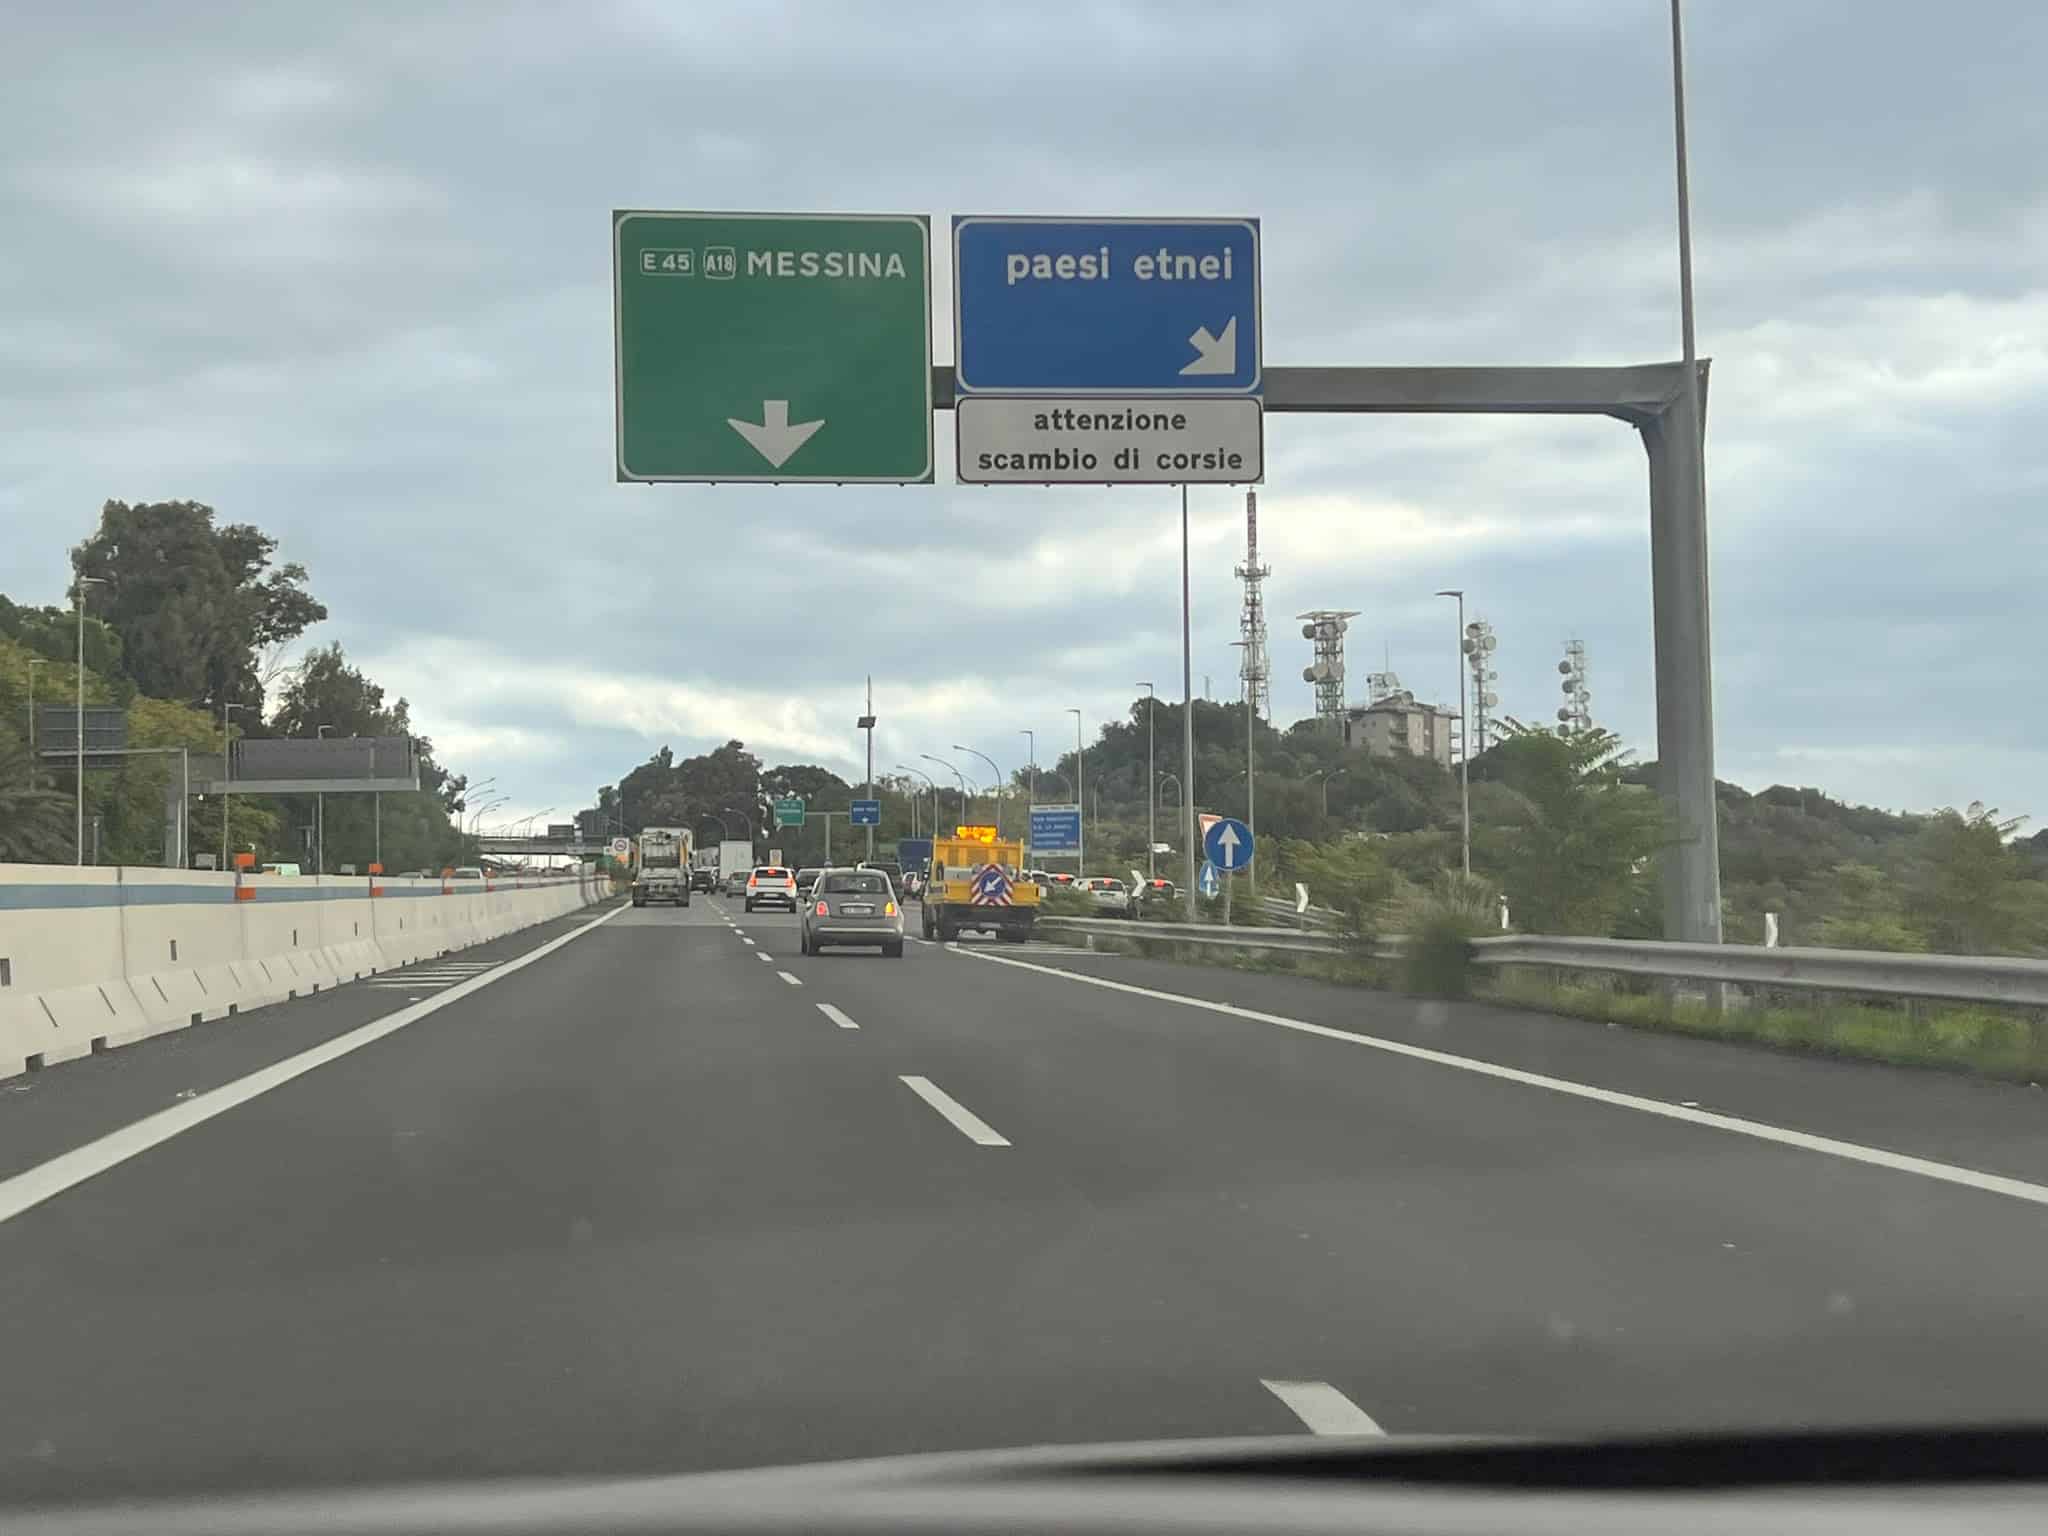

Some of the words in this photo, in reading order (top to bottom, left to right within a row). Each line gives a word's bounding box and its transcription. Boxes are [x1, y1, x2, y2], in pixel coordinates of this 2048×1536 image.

[643, 252, 656, 271] E
[660, 252, 690, 271] 45
[706, 252, 734, 274] A18
[747, 251, 906, 278] MESSINA
[1007, 246, 1110, 285] paesi
[1134, 247, 1232, 280] etnei
[1034, 408, 1187, 431] attenzione
[978, 447, 1098, 471] scambio
[1113, 447, 1141, 470] di
[1156, 447, 1243, 471] corsie
